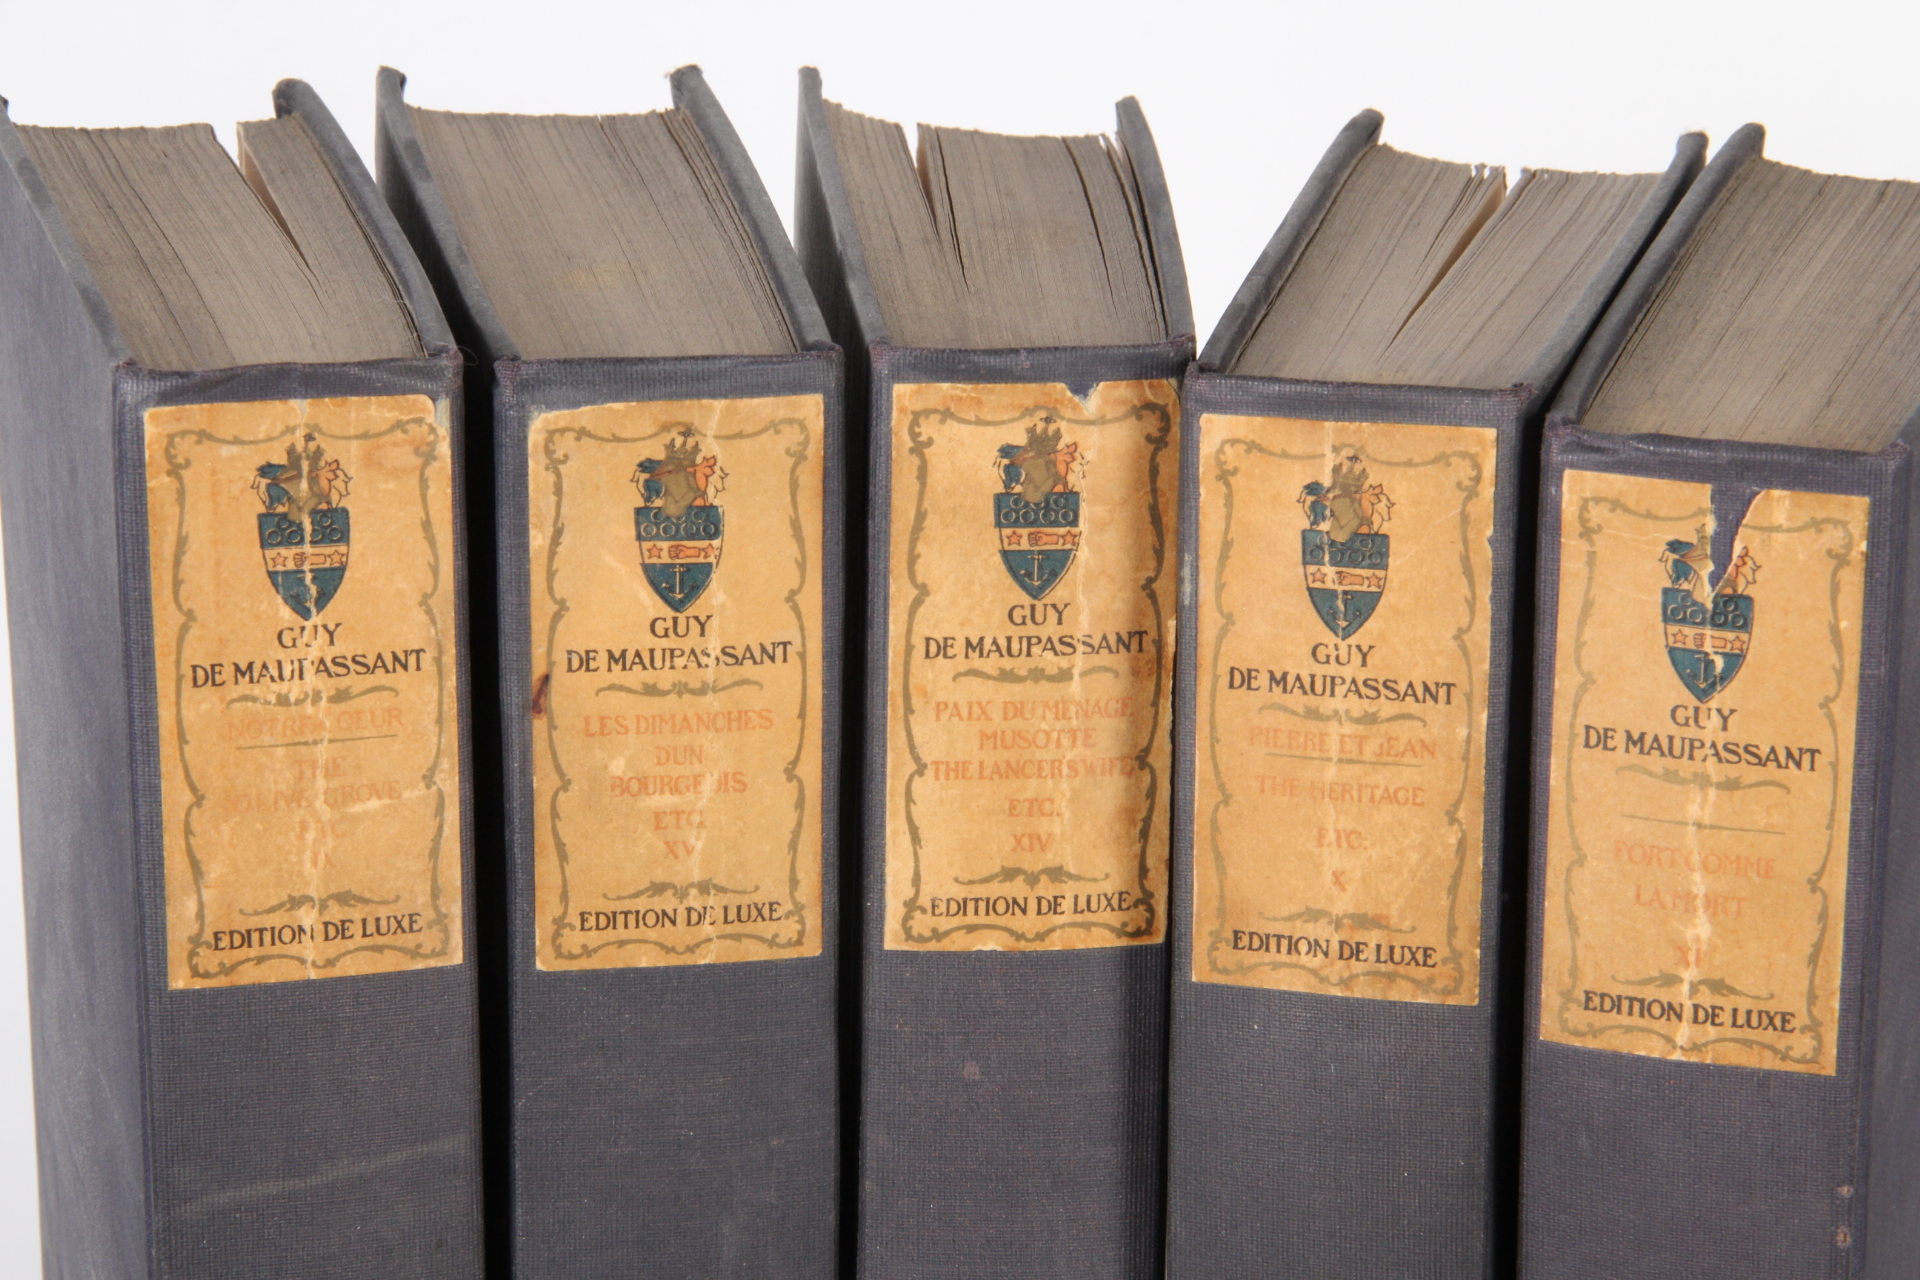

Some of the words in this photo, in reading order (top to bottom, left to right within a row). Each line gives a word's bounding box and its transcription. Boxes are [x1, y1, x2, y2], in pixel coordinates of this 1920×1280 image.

[649, 614, 714, 639] GUY
[1007, 602, 1072, 626] GUY
[277, 622, 343, 649] GUY
[923, 635, 958, 660] DE
[963, 629, 1149, 660] MAUPASSANT
[566, 649, 600, 674] DE
[606, 640, 794, 673] MAUPASSANT
[1310, 642, 1376, 668] GUY
[190, 662, 226, 689] DE
[1228, 666, 1262, 692] DE
[1267, 669, 1457, 706] MAUPASSANT
[583, 713, 631, 738] LES
[634, 708, 775, 736] DIMANCHES
[934, 699, 993, 722] PAIX
[1003, 699, 1038, 722] DU
[1670, 704, 1738, 732] GUY
[977, 727, 1098, 752] MUSOTTE
[1248, 725, 1331, 755] PIERRE
[1338, 733, 1371, 756] ET
[1373, 736, 1438, 760] JEAN
[1582, 724, 1618, 752] DE
[1623, 728, 1823, 773] MAUPASSANT
[930, 759, 974, 782] THE
[1253, 773, 1302, 799] THE
[1308, 778, 1427, 809] HERITAGE
[1007, 796, 1063, 819] ETC.
[662, 839, 698, 861] XV
[1010, 832, 1054, 854] XIV
[1613, 839, 1682, 868] FORT
[1684, 850, 1777, 880] COMME
[1330, 869, 1348, 894] X
[930, 895, 1029, 918] EDITION
[1035, 894, 1067, 917] DE
[1073, 890, 1134, 914] LUXE
[1633, 883, 1666, 910] LA
[1670, 889, 1749, 918] MORT
[578, 908, 679, 933] EDITION
[686, 905, 717, 928] DE
[722, 901, 784, 925] LUXE
[212, 923, 315, 952] EDITION
[322, 919, 356, 942] DE
[361, 912, 424, 939] LUXE
[1231, 929, 1331, 960] EDITION
[1337, 940, 1369, 963] DE
[1374, 943, 1438, 969] LUXE
[1674, 943, 1704, 970] XI
[1582, 989, 1684, 1023] EDITION
[1692, 1002, 1725, 1027] DE
[1730, 1006, 1797, 1034] LUXE
